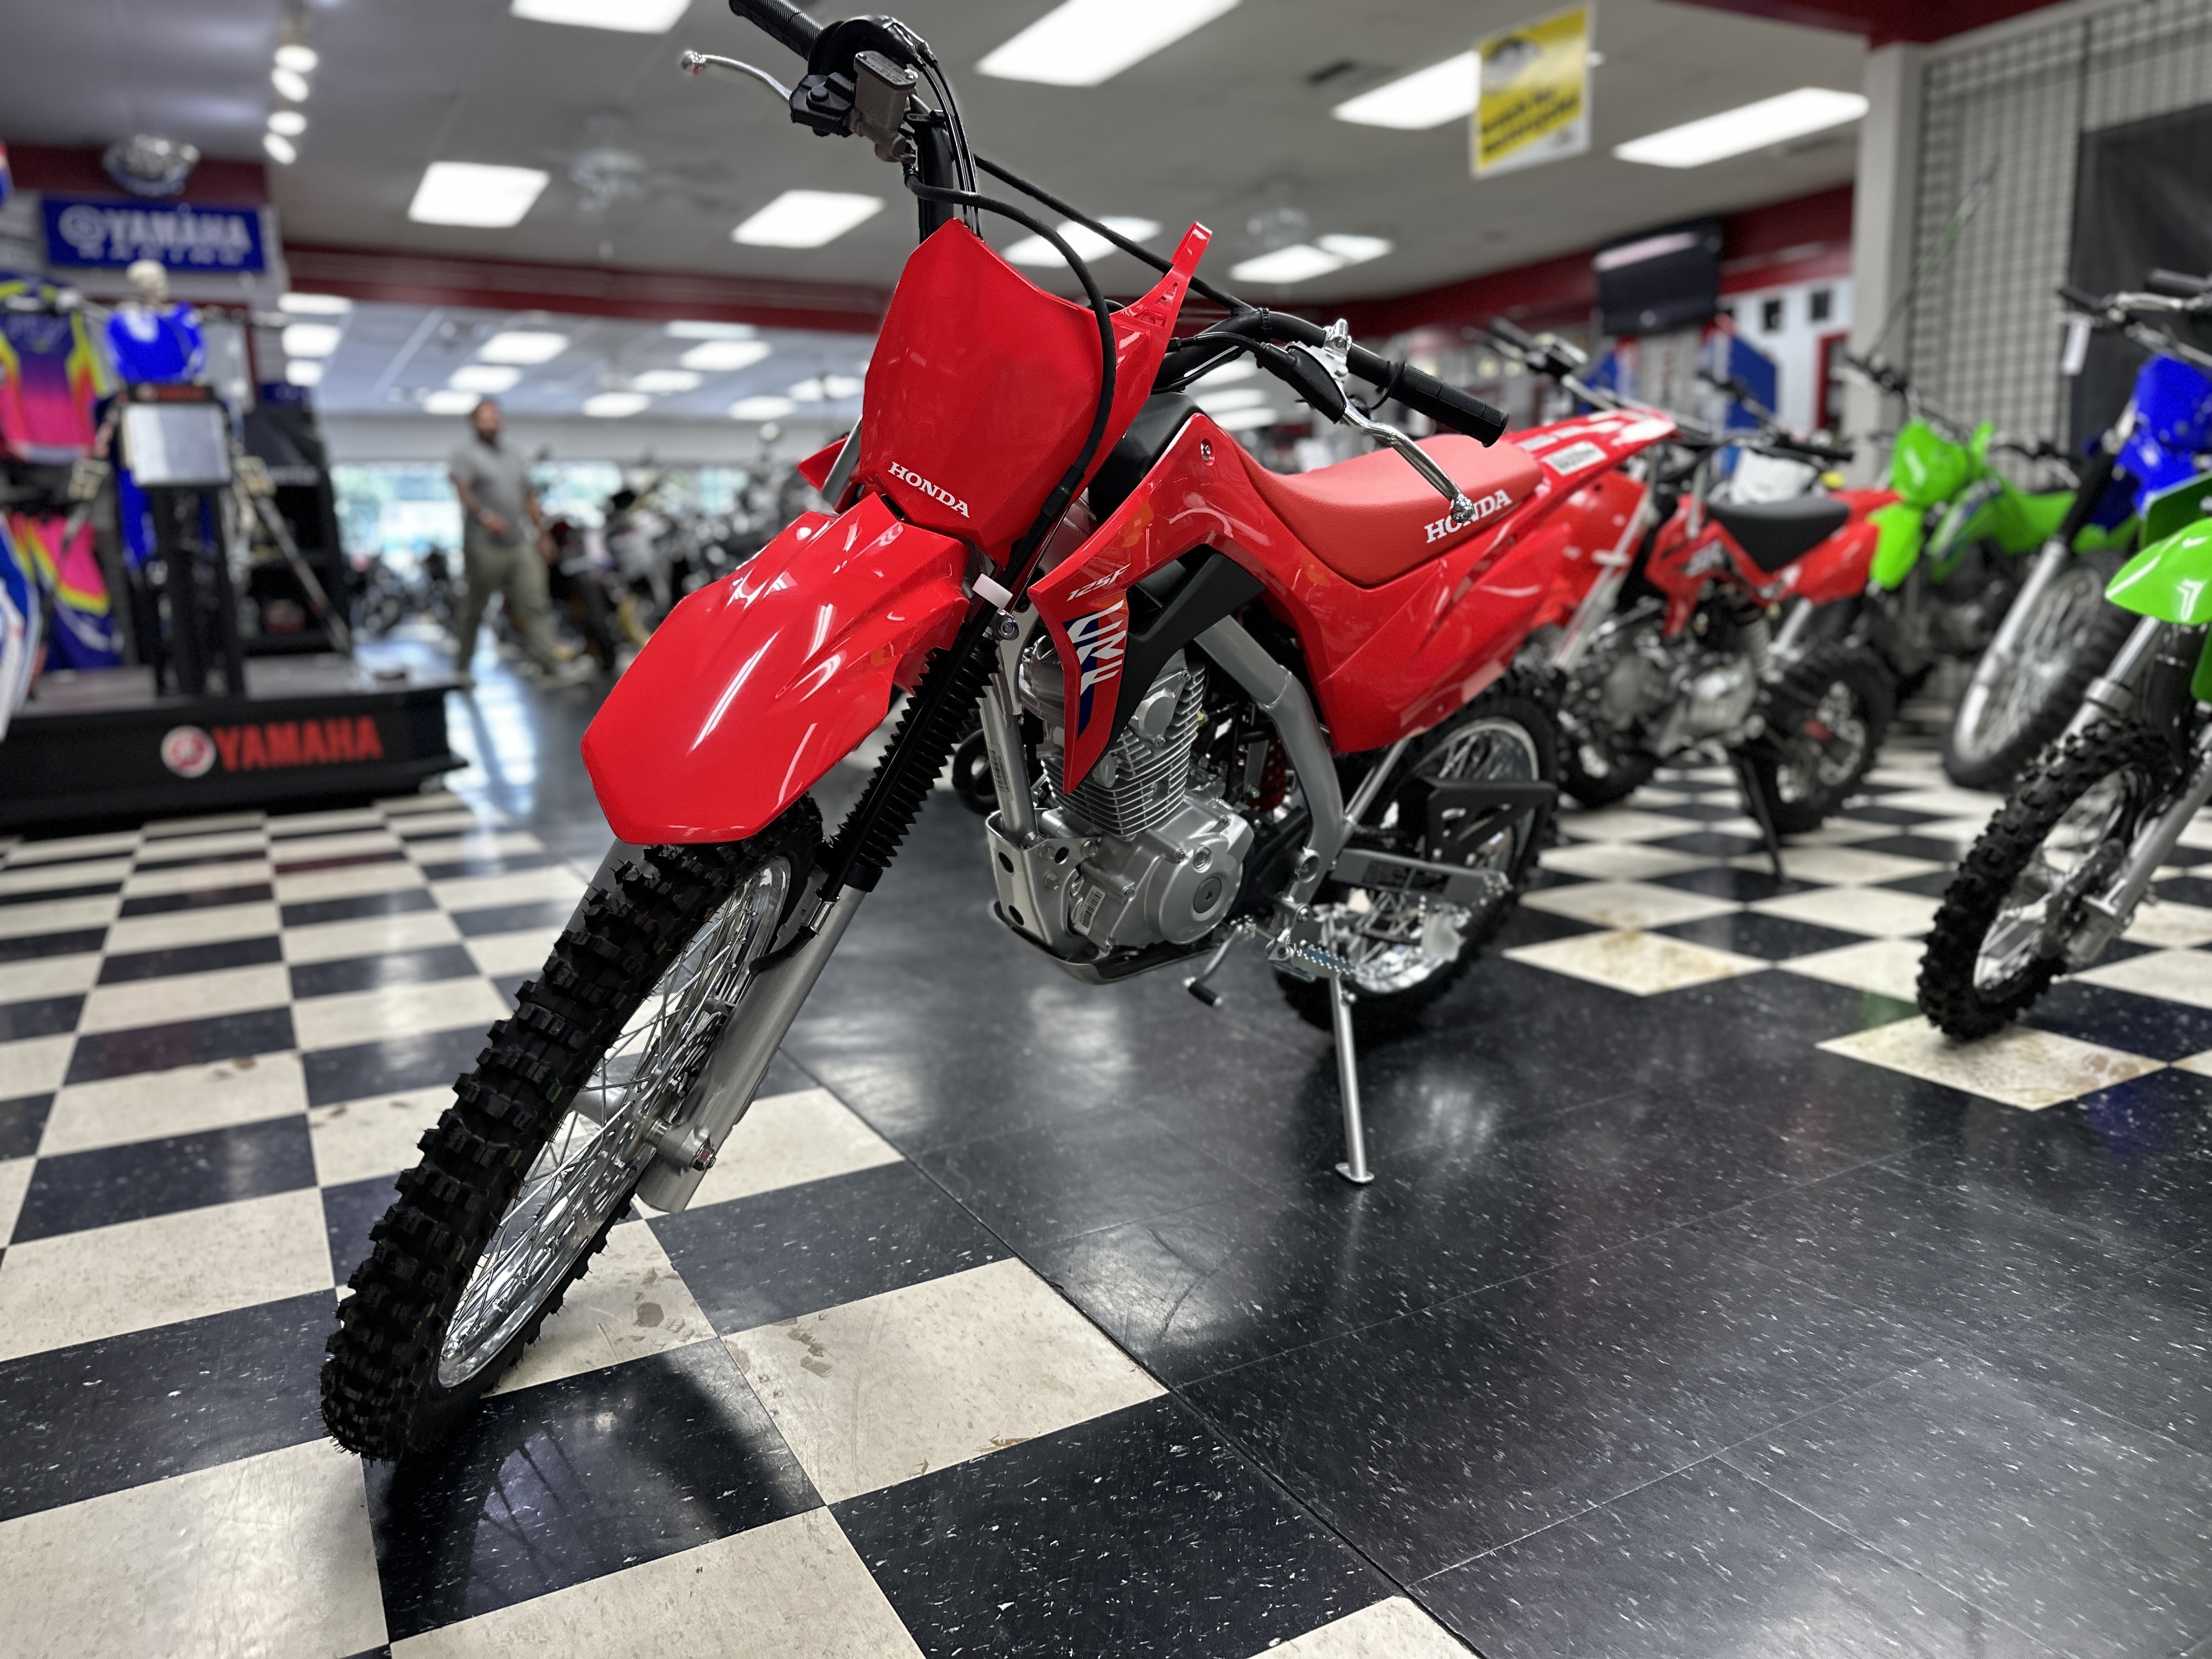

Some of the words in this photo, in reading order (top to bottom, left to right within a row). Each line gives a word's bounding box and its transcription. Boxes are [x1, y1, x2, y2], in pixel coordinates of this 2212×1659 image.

[103, 209, 251, 252] YAMAHA
[888, 461, 970, 518] HONDA
[1066, 562, 1132, 602] 125F
[1066, 599, 1126, 696] CRF
[211, 715, 383, 772] YAMAHA
